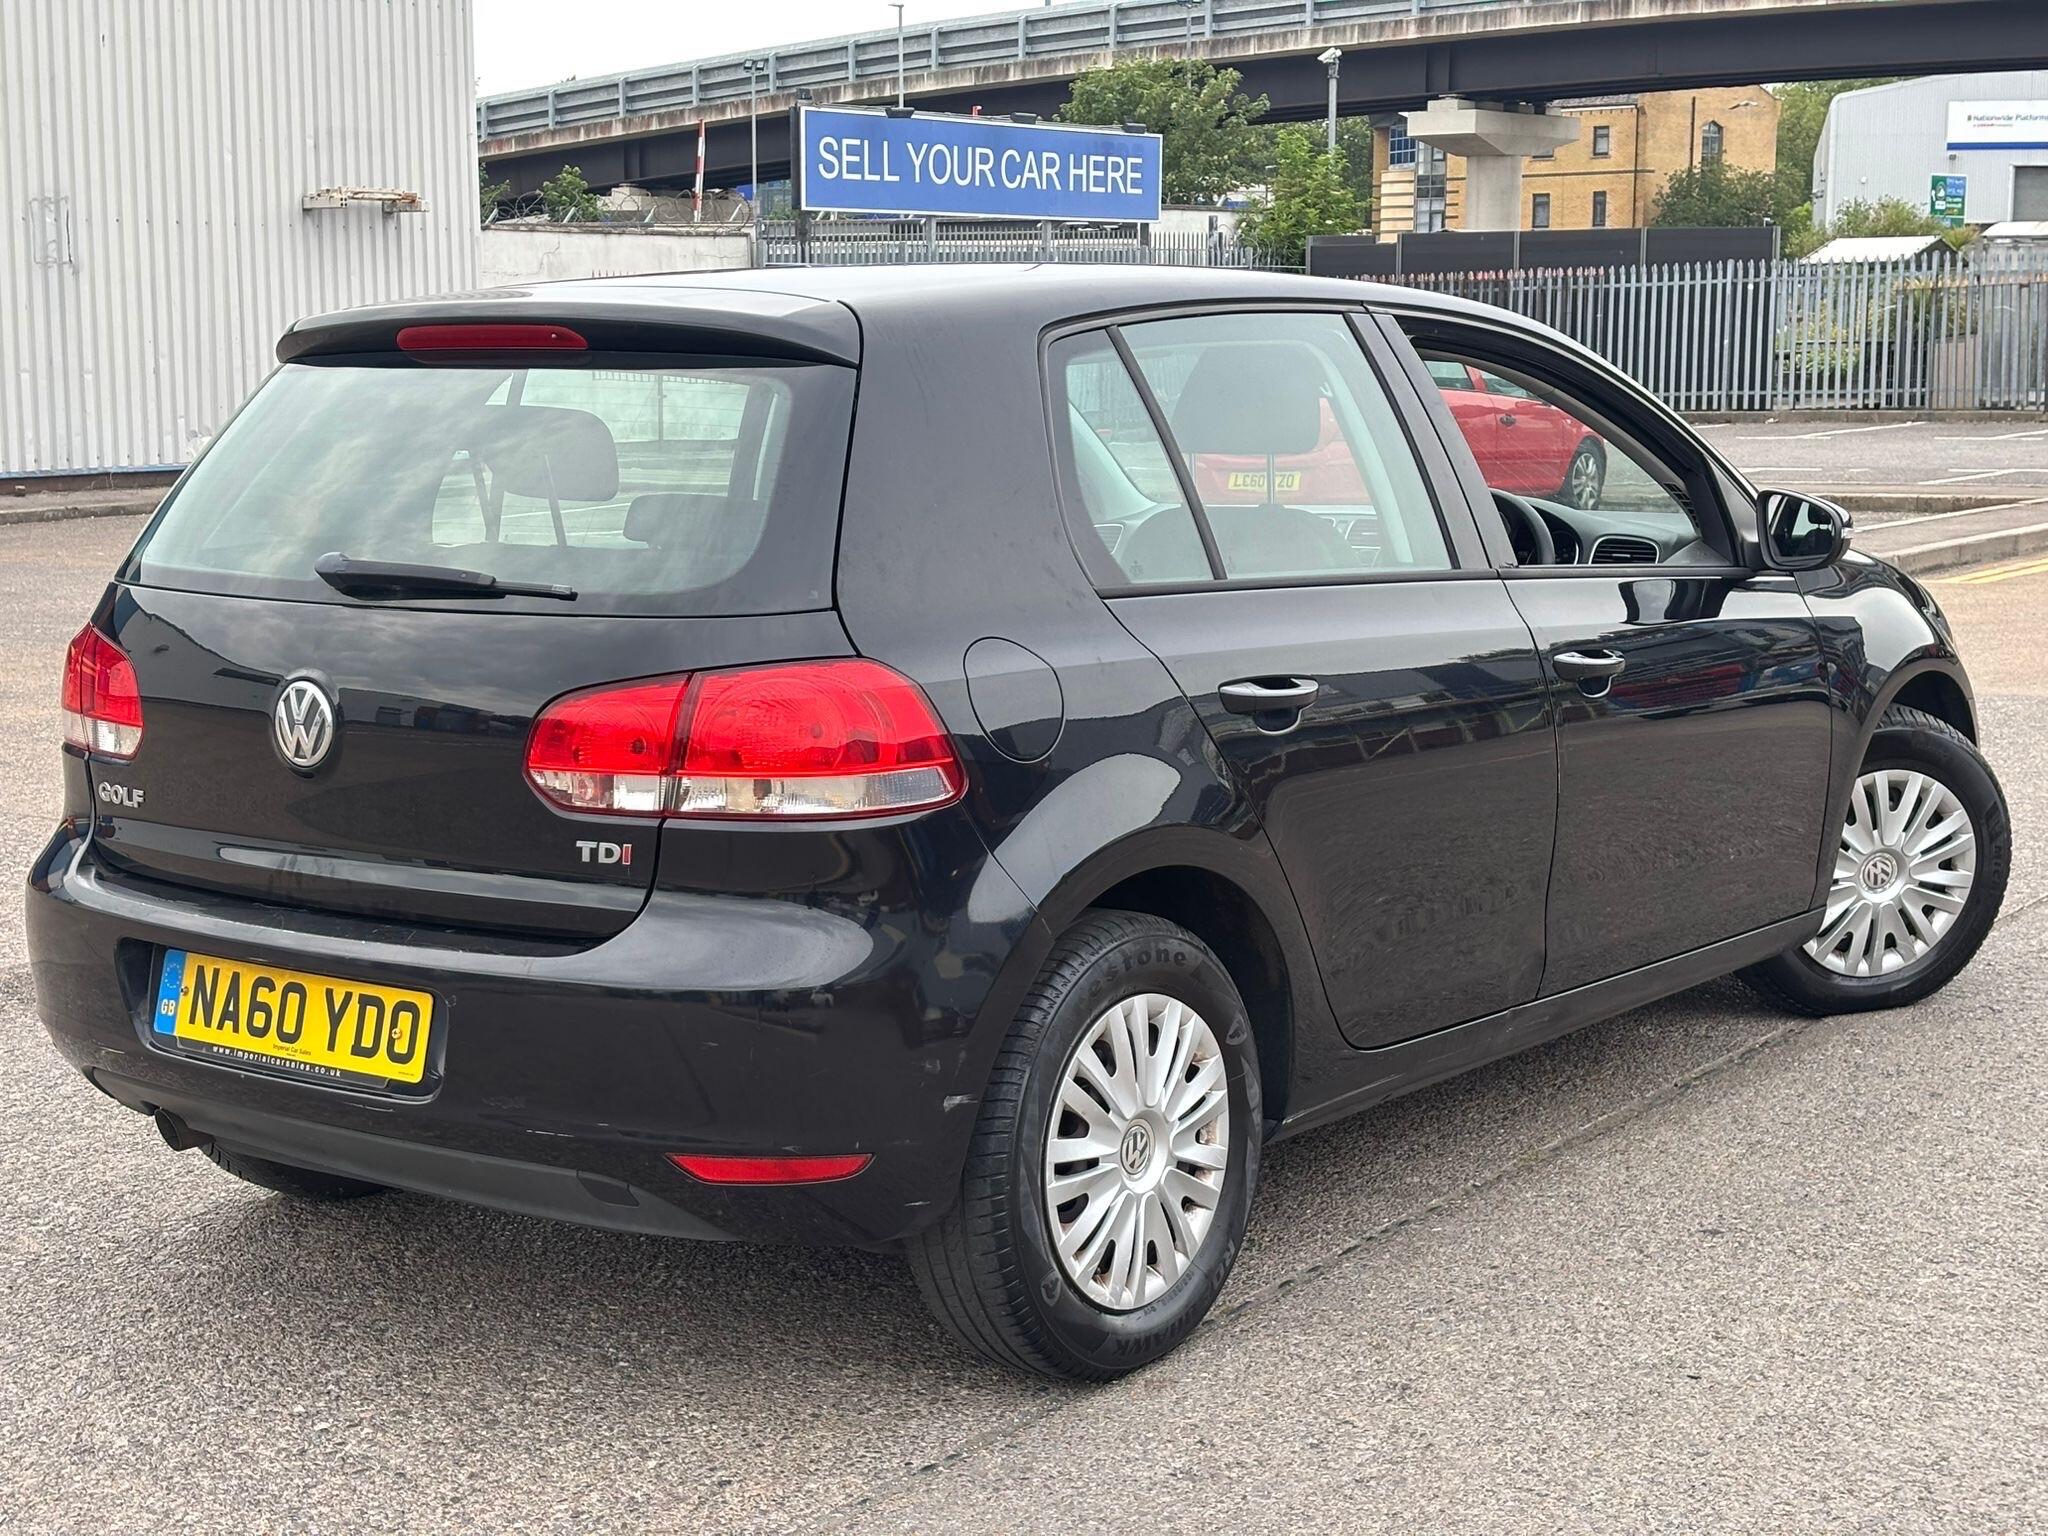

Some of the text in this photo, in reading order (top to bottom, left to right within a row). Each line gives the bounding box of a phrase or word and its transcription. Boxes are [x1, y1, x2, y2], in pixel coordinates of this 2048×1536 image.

[817, 136, 1144, 195] SELL YOUR CAR HERE
[98, 781, 145, 809] GOLF
[575, 840, 633, 866] TDI
[160, 998, 177, 1017] GB
[188, 964, 421, 1065] NA60 YDO
[212, 1046, 341, 1077] www.imperialcarsales.co.uk
[272, 1043, 290, 1053] Imperial
[290, 1046, 299, 1054] Car
